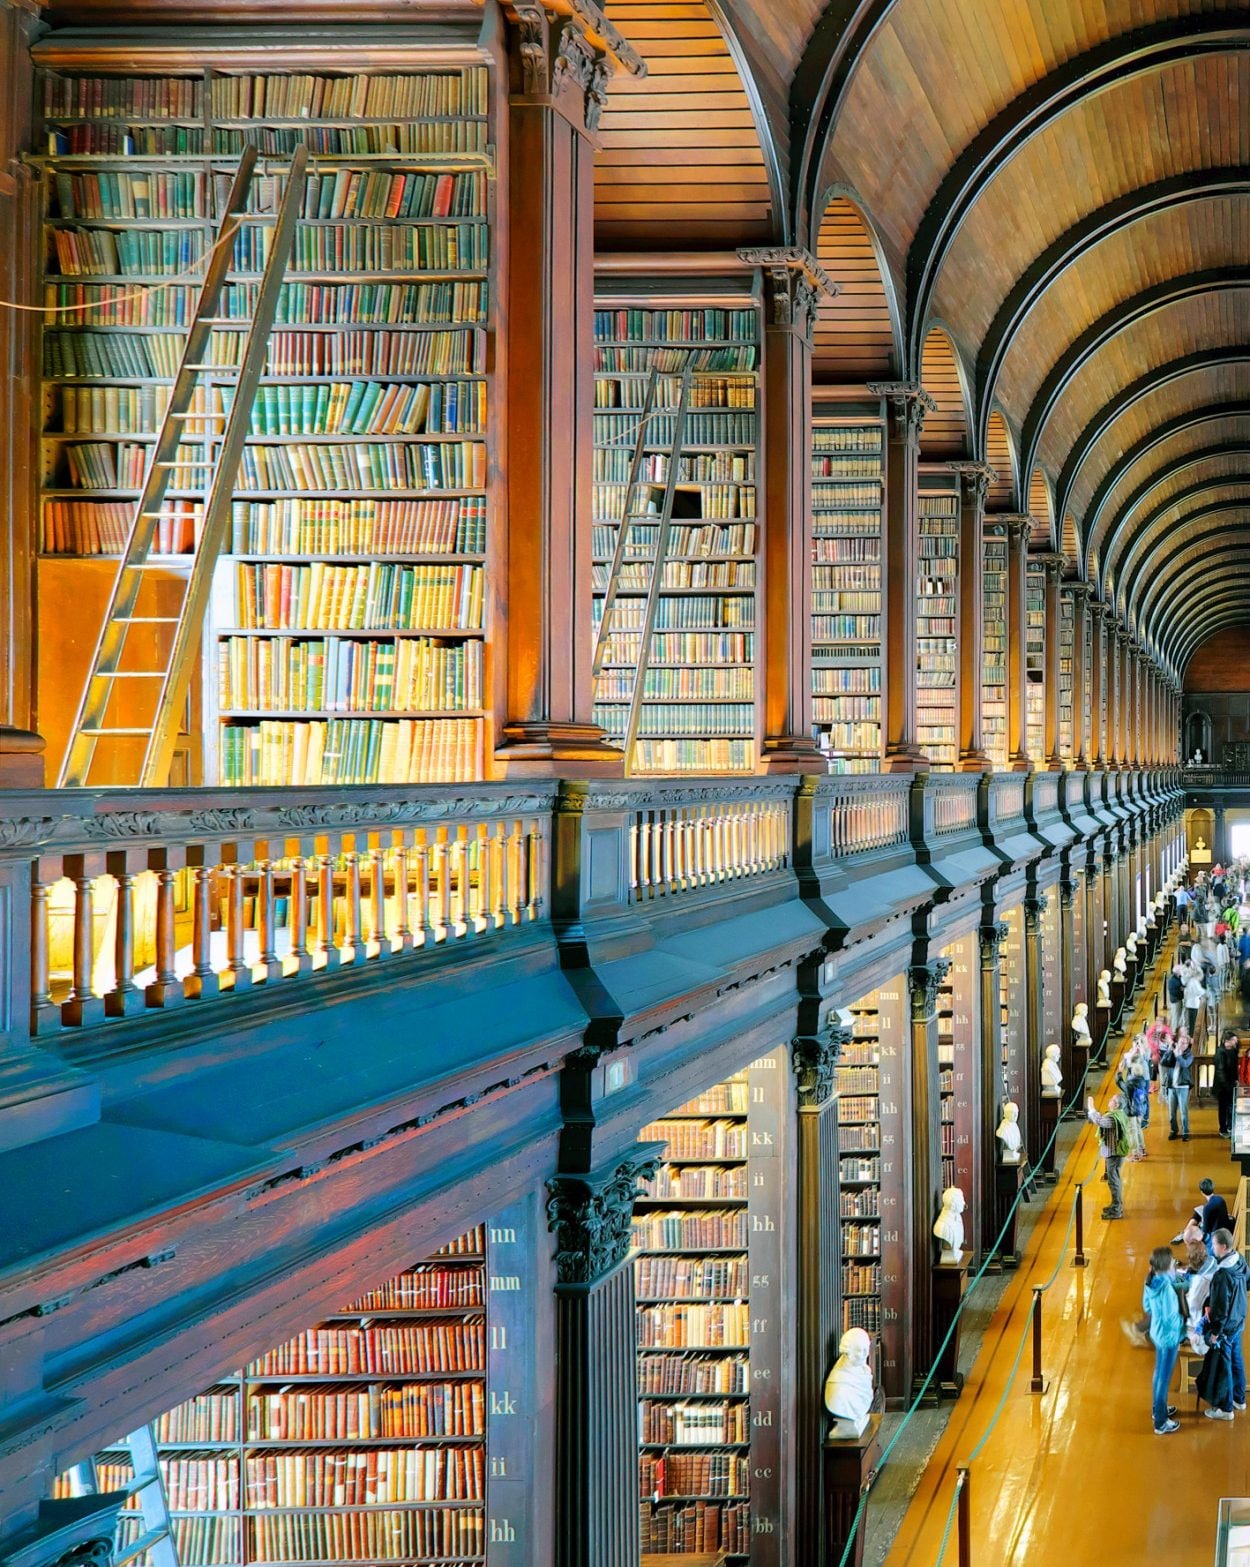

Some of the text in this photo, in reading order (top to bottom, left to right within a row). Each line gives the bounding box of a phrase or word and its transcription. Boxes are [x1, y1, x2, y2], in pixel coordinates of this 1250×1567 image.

[879, 992, 898, 1000] mm
[882, 1017, 890, 1029] ll
[881, 1046, 896, 1056] kk
[883, 1076, 890, 1084] ii
[753, 1088, 763, 1102] ll
[881, 1102, 897, 1114] hh
[752, 1132, 772, 1144] kk
[883, 1162, 892, 1172] ff
[754, 1173, 764, 1186] ii
[752, 1215, 774, 1231] hh
[490, 1229, 516, 1243] nn
[883, 1231, 898, 1242] dd
[752, 1275, 769, 1286] gg
[884, 1273, 897, 1282] cc
[489, 1276, 520, 1293] mm
[882, 1308, 897, 1319] bb
[753, 1319, 766, 1333] ff
[491, 1326, 506, 1350] ll
[753, 1370, 770, 1379] ee
[491, 1392, 516, 1414] kk
[753, 1411, 771, 1426] dd
[492, 1457, 506, 1476] ii
[755, 1469, 771, 1478] cc
[490, 1519, 514, 1542] hh
[755, 1517, 773, 1533] bb
